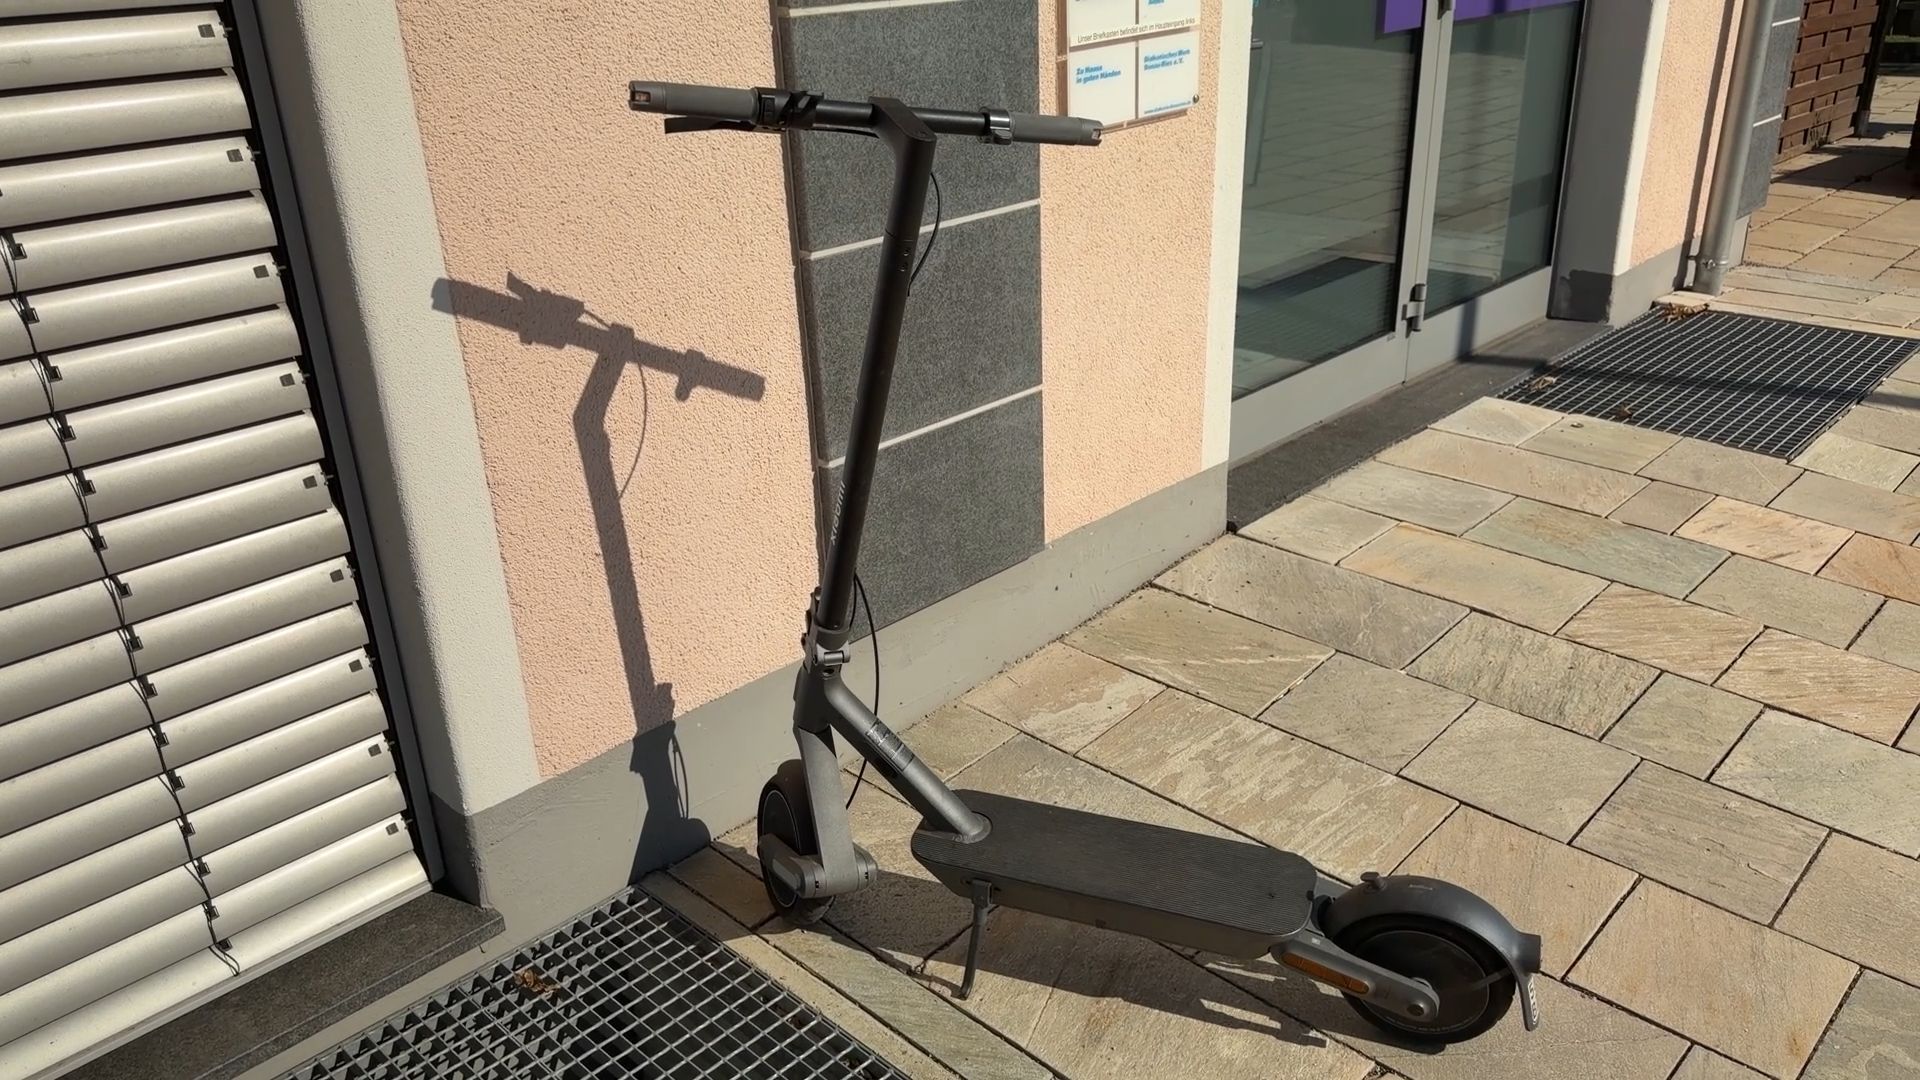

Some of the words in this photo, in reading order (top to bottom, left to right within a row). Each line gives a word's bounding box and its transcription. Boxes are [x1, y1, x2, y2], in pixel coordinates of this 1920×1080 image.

[1077, 34, 1093, 43] Unser
[1093, 30, 1119, 41] Briefkasten
[1120, 27, 1138, 36] befindet
[1083, 73, 1099, 84] guten
[1100, 69, 1121, 80] Händen
[831, 480, 846, 547] xiaomi
